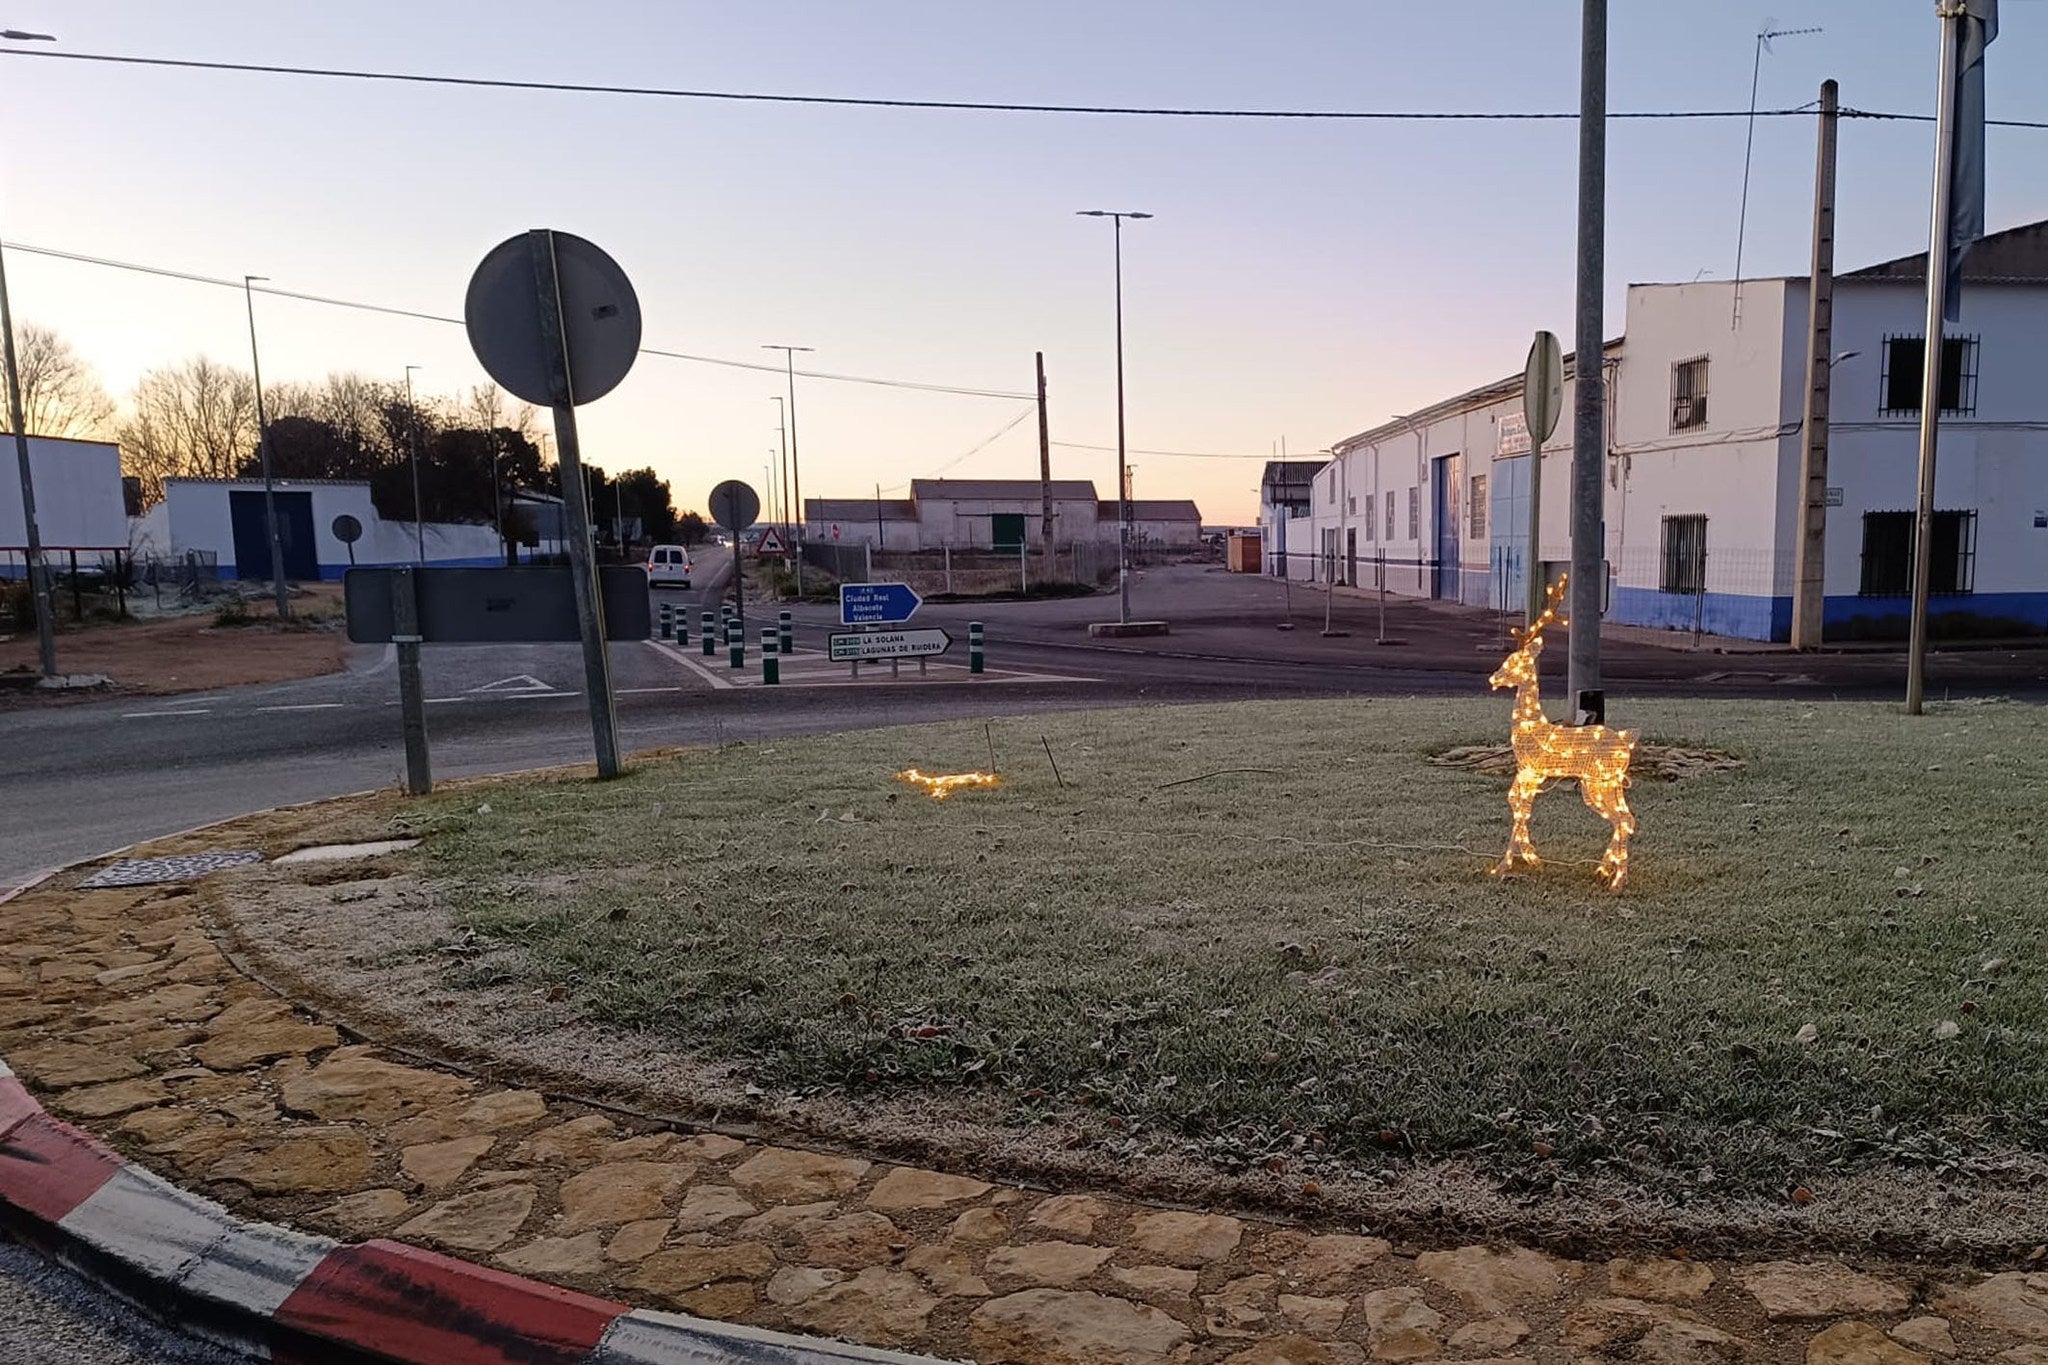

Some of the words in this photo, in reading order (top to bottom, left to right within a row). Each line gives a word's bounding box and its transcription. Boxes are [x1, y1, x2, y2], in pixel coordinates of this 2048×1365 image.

[845, 594, 870, 602] Ciudad
[873, 593, 889, 601] Real
[852, 604, 883, 612] Albacete
[853, 613, 883, 621] Valencia
[863, 636, 871, 644] LA
[876, 635, 905, 643] SOLANA
[862, 645, 896, 655] LAGUNAS
[912, 644, 941, 652] RUIDERA
